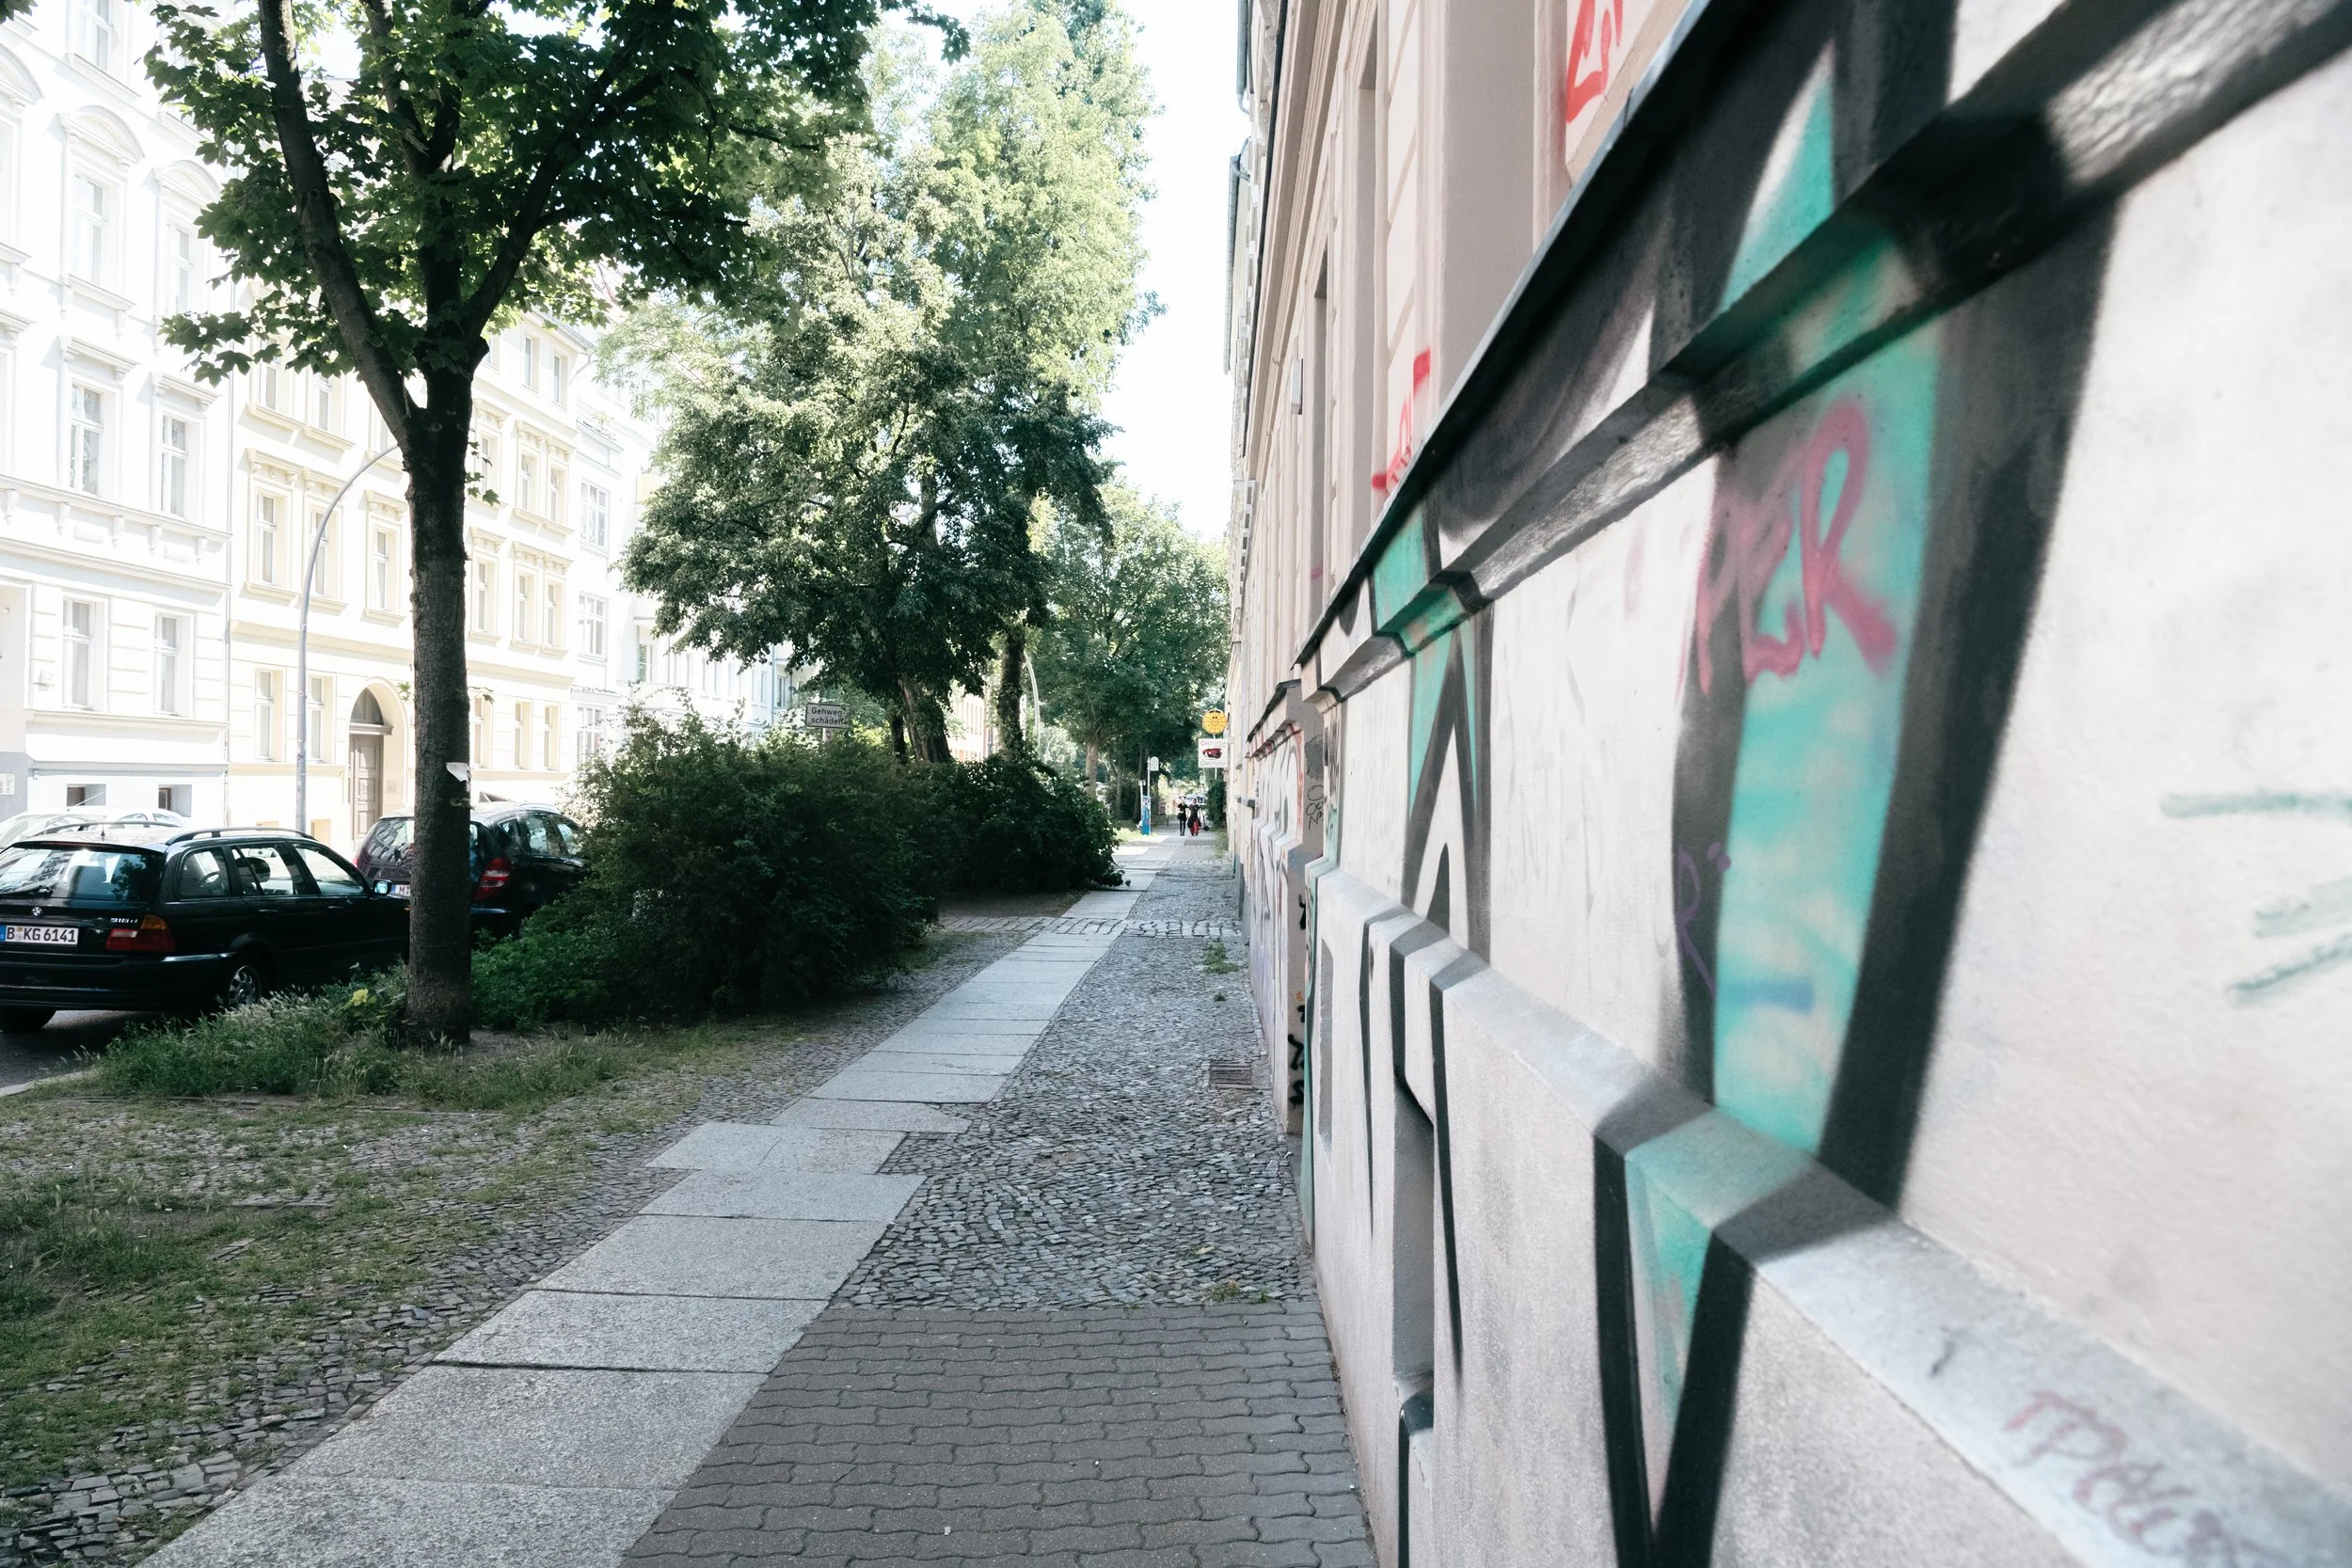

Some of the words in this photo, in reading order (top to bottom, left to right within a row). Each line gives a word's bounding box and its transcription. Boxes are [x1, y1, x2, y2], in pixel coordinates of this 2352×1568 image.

[7, 927, 15, 940] B
[24, 927, 41, 942] KG
[43, 928, 76, 942] 6141
